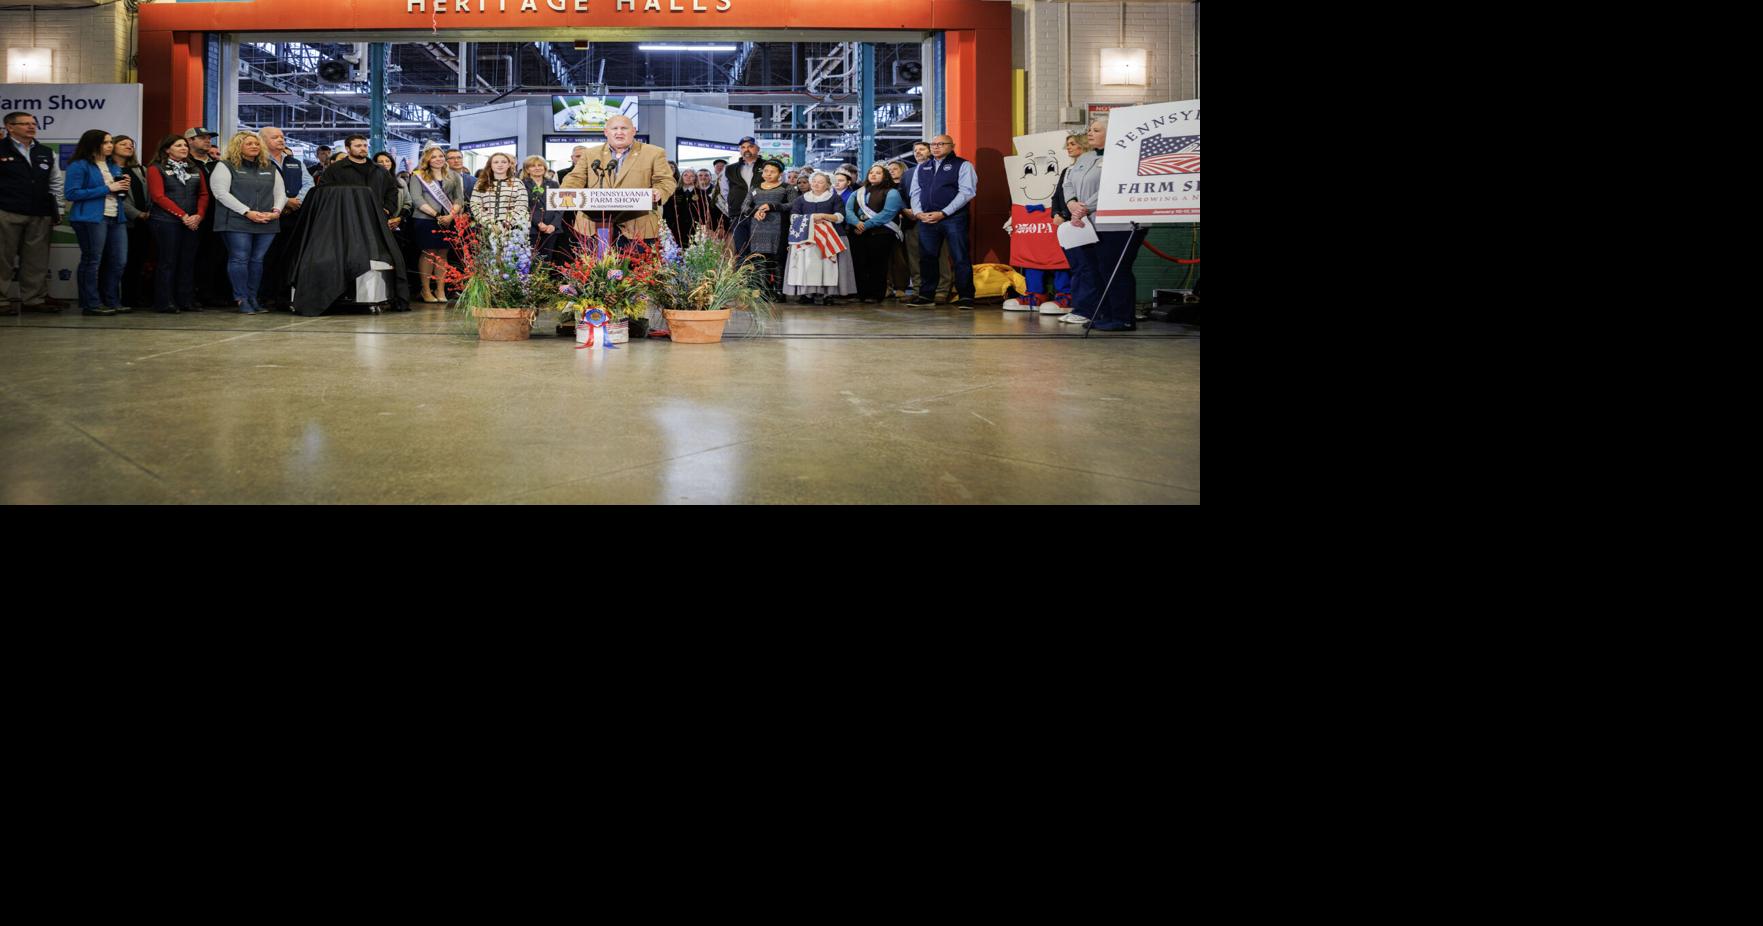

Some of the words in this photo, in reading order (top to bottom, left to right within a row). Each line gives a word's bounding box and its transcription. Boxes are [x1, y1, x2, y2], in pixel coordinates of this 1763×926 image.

[407, 0, 588, 12] HERITAGE
[616, 0, 732, 12] HALLS
[0, 95, 42, 110] arm
[48, 94, 106, 110] Show
[1118, 182, 1174, 194] FARM
